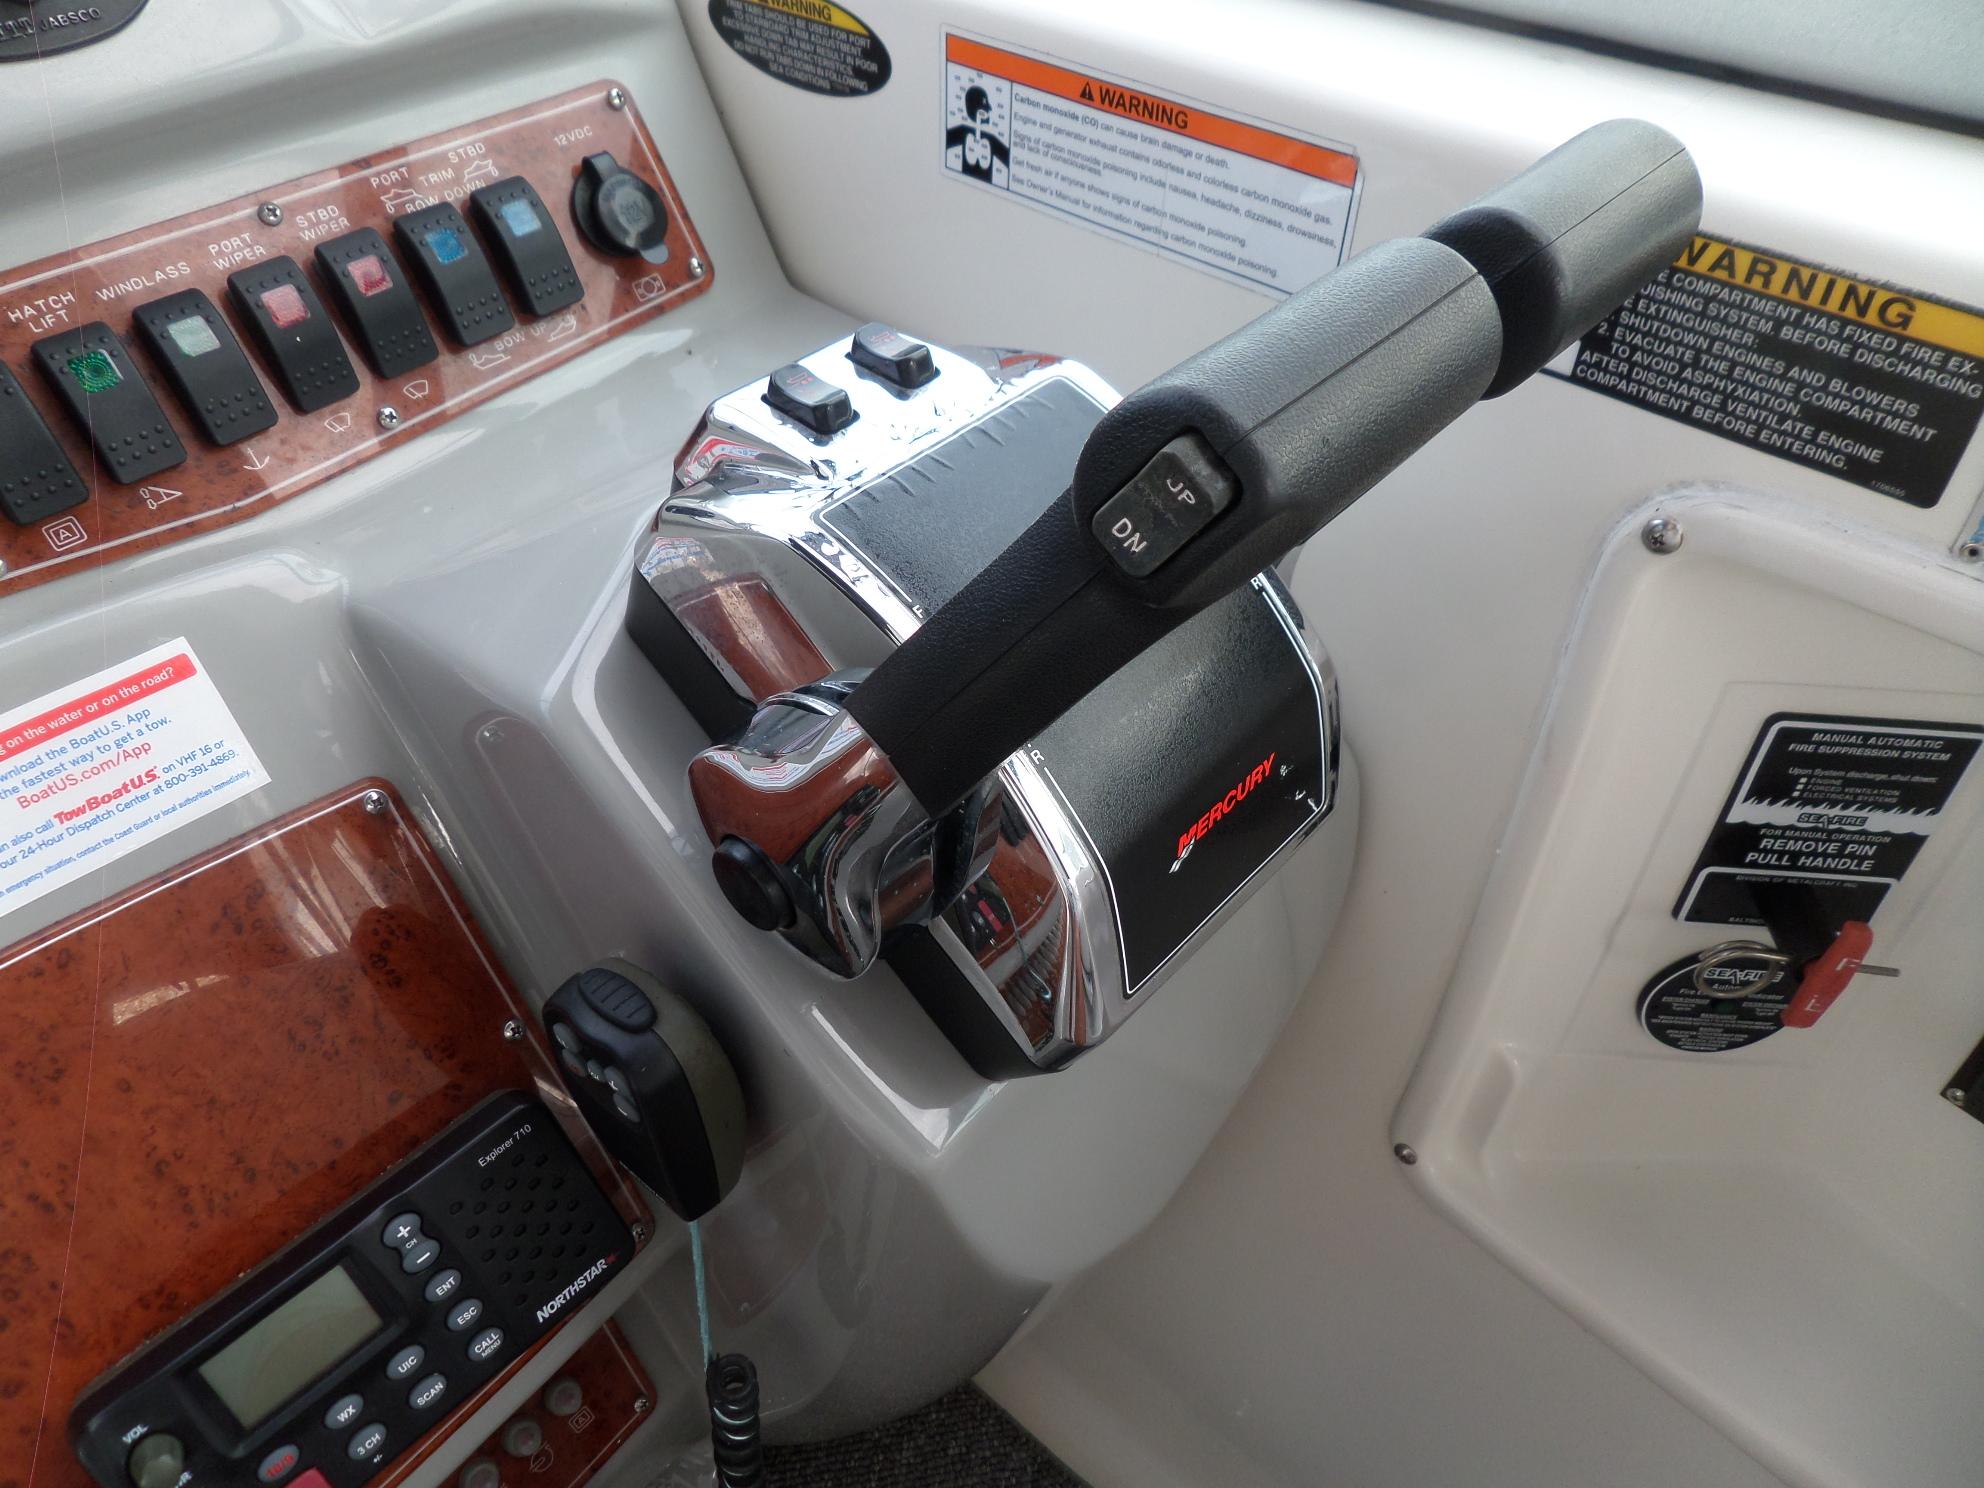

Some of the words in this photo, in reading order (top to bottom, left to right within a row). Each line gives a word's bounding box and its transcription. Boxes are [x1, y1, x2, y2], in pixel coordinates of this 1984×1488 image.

[40, 7, 100, 31] JABSCO
[1099, 84, 1189, 131] WARNING
[554, 126, 592, 146] 12VDC
[1014, 92, 1040, 108] Carbon
[1042, 103, 1079, 122] monoxide
[1081, 114, 1098, 129] (CO)
[1100, 122, 1113, 132] can
[1115, 127, 1138, 140] cause
[1140, 133, 1159, 147] brain
[1161, 140, 1192, 158] damage
[1194, 151, 1203, 160] or
[1204, 154, 1228, 169] death.
[448, 142, 486, 163] STBD
[371, 167, 409, 188] PORT
[419, 168, 455, 187] TRIM
[405, 196, 439, 213] BOW
[444, 179, 487, 200] DOWN
[296, 205, 339, 228] STBD
[299, 218, 351, 241] WIPER
[208, 233, 253, 256] PORT
[213, 245, 266, 271] WIPER
[96, 262, 191, 301] WINDLASS
[7, 291, 76, 323] HATCH
[29, 309, 70, 333] LIFT
[1637, 298, 1761, 347] EXTINGUISHER:
[1672, 273, 1800, 321] COMPARTMENT
[1801, 312, 1840, 335] HAS
[1842, 324, 1898, 351] FIXED
[1899, 342, 1945, 366] FIRE
[1946, 355, 1979, 375] EX-
[494, 333, 525, 351] BOW
[530, 323, 548, 336] UP
[1707, 302, 1778, 334] SYSTEM.
[1779, 325, 1852, 357] BEFORE
[1854, 348, 1982, 398] DISCHARGING
[1619, 310, 1710, 350] SHUTDOWN
[1711, 340, 1785, 374] ENGINES
[1786, 365, 1826, 387] AND
[1828, 378, 1920, 417] BLOWERS
[1610, 341, 1630, 358] TO
[1631, 350, 1680, 375] AVOID
[1681, 367, 1803, 417] ASPHYXIATION.
[1614, 326, 1695, 363] EVACUATE
[1699, 354, 1731, 375] THE
[1732, 365, 1796, 396] ENGINE
[1799, 387, 1936, 441] COMPARTMENT
[1576, 364, 1690, 412] COMPARTMENT
[1691, 404, 1757, 438] BEFORE
[1758, 428, 1849, 470] ENTERING.
[1580, 349, 1629, 375] AFTER
[1631, 367, 1723, 407] DISCHARGE
[1727, 399, 1814, 439] VENTILATE
[1816, 430, 1883, 463] ENGINE
[1112, 517, 1148, 553] DN
[912, 604, 924, 619] F
[5, 735, 24, 748] on
[23, 725, 47, 740] the
[46, 708, 82, 729] water
[85, 701, 99, 713] or
[101, 693, 119, 706] on
[118, 684, 140, 698] the
[140, 666, 174, 689] road?
[44, 745, 69, 760] the
[68, 720, 125, 749] BoatU.S.
[126, 708, 151, 725] App
[1811, 733, 1863, 744] MANUAL
[1867, 736, 1944, 748] AUTOMATIC
[0, 785, 20, 800] the
[21, 762, 67, 789] fastest
[68, 750, 94, 767] way
[95, 743, 112, 754] to
[113, 732, 134, 750] get
[135, 728, 145, 736] a
[144, 716, 172, 732] tow.
[1030, 748, 1045, 765] R
[1787, 743, 1816, 752] FIRE
[1817, 745, 1901, 757] SUPPRESSION
[1901, 750, 1951, 760] SYSTEM
[16, 742, 151, 809] BoatUS.com/App
[10, 831, 34, 847] also
[34, 818, 54, 834] call
[161, 763, 176, 774] on
[175, 750, 197, 766] VHF
[198, 743, 213, 756] 16
[213, 739, 224, 749] or
[18, 832, 64, 859] 24-Hour
[65, 809, 116, 837] Dispatch
[115, 791, 150, 813] Center
[152, 784, 164, 795] at
[163, 749, 235, 789] 800-391-4869.
[1177, 752, 1276, 859] MERCURY
[1759, 828, 1783, 836] FOR
[1784, 830, 1828, 839] MANUAL
[1831, 833, 1892, 843] OPERATION
[1759, 838, 1841, 853] REMOVE
[1844, 844, 1877, 855] PIN
[1744, 852, 1791, 864] PULL
[1797, 856, 1874, 870] HANDLE
[477, 1137, 514, 1167] Explorer
[514, 1124, 532, 1141] 710
[405, 1238, 418, 1249] CH
[435, 1276, 456, 1297] ENT
[536, 1258, 608, 1323] NORTHSTAR
[457, 1306, 477, 1325] ESC
[474, 1331, 500, 1354] CALL
[481, 1340, 501, 1358] MENU
[397, 1355, 418, 1374] UIC
[417, 1381, 444, 1406] SCAN
[336, 1404, 357, 1423] WX
[122, 1424, 149, 1444] VOL
[356, 1446, 365, 1456] 3
[365, 1432, 381, 1448] CH
